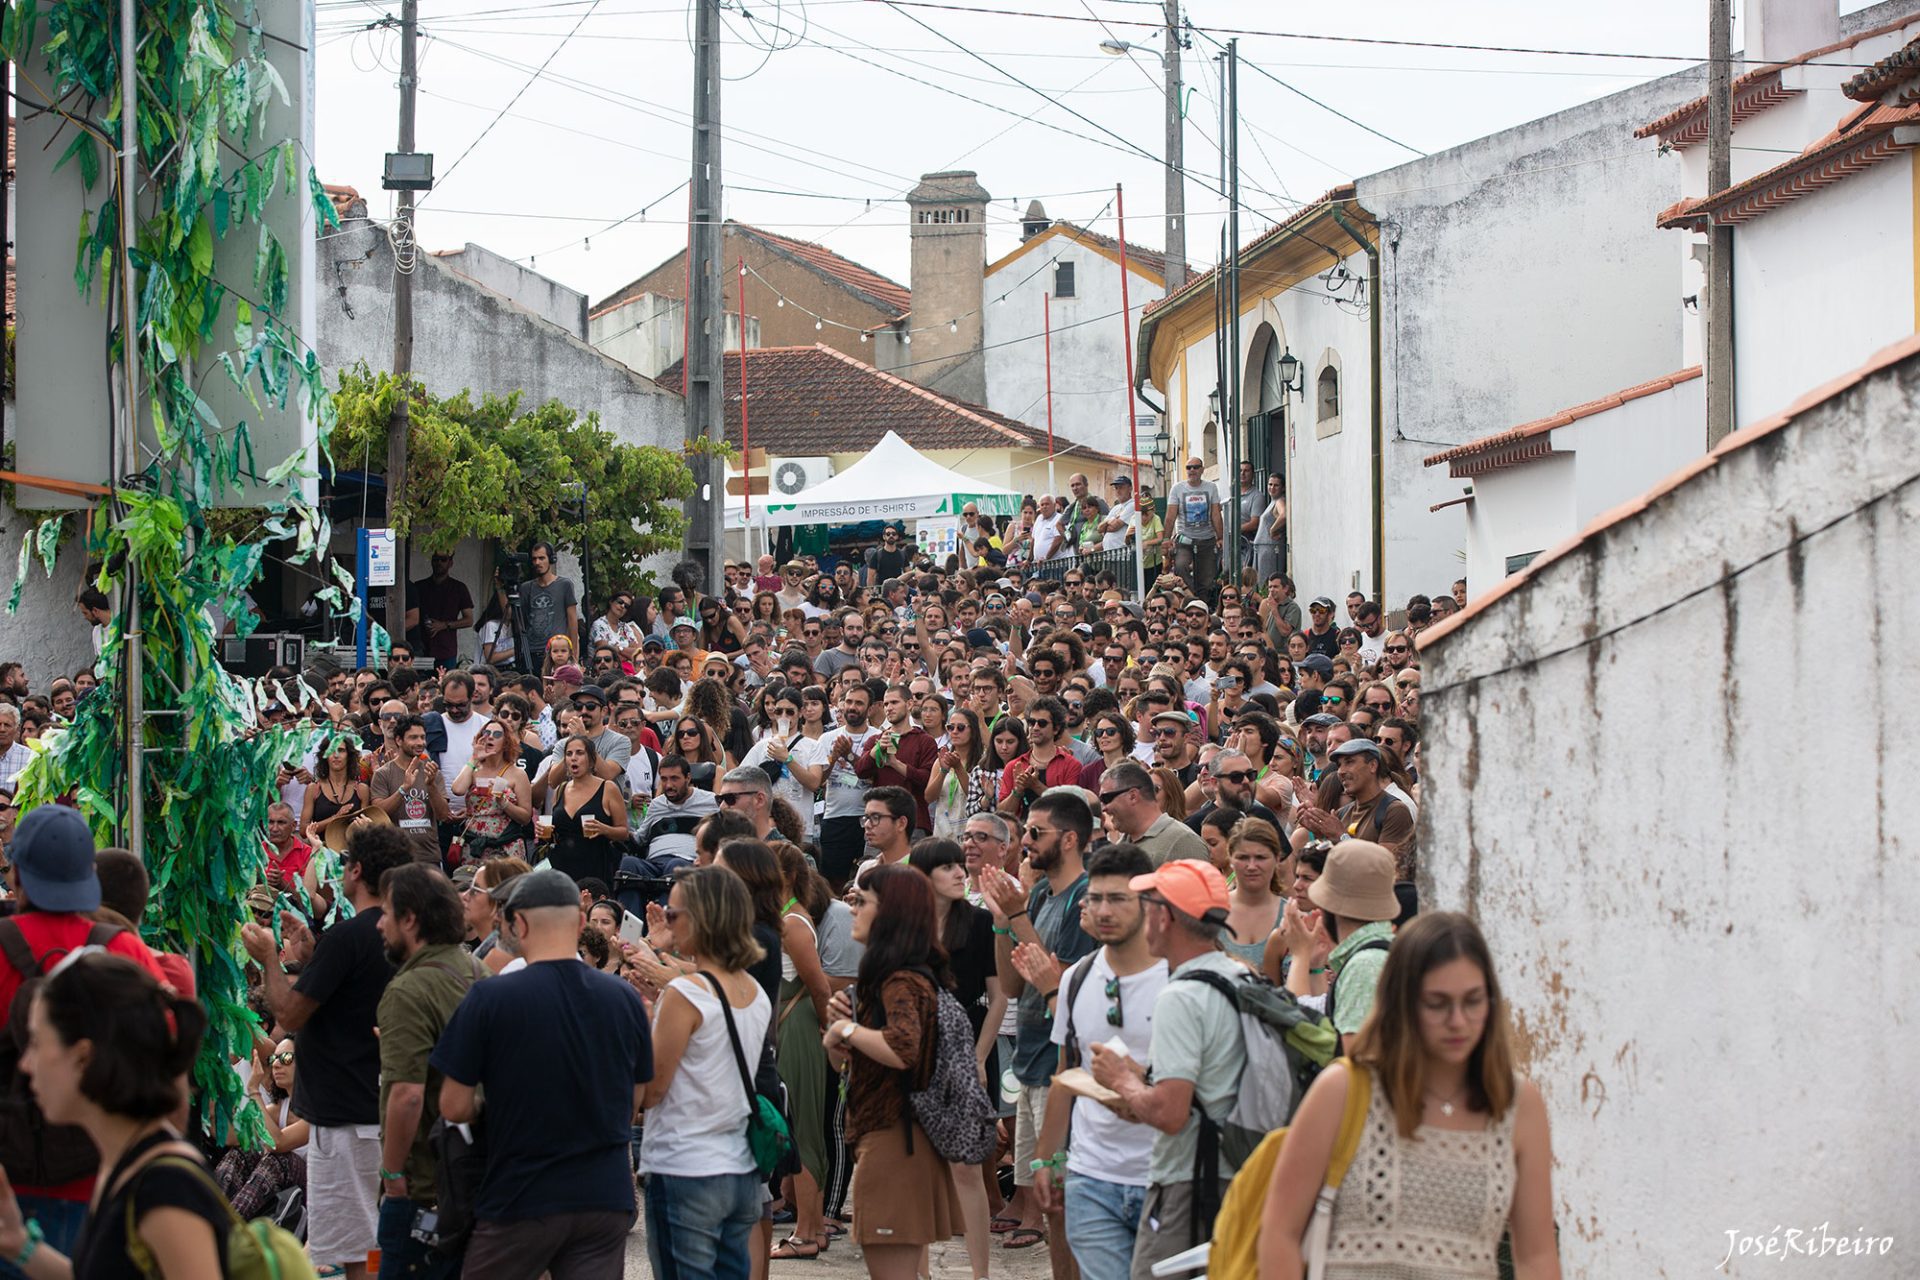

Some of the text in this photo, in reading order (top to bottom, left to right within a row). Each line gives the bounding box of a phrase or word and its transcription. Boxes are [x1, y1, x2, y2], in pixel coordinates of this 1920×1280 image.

[801, 502, 916, 518] IMPRESSÃO DE T-SHIRTS
